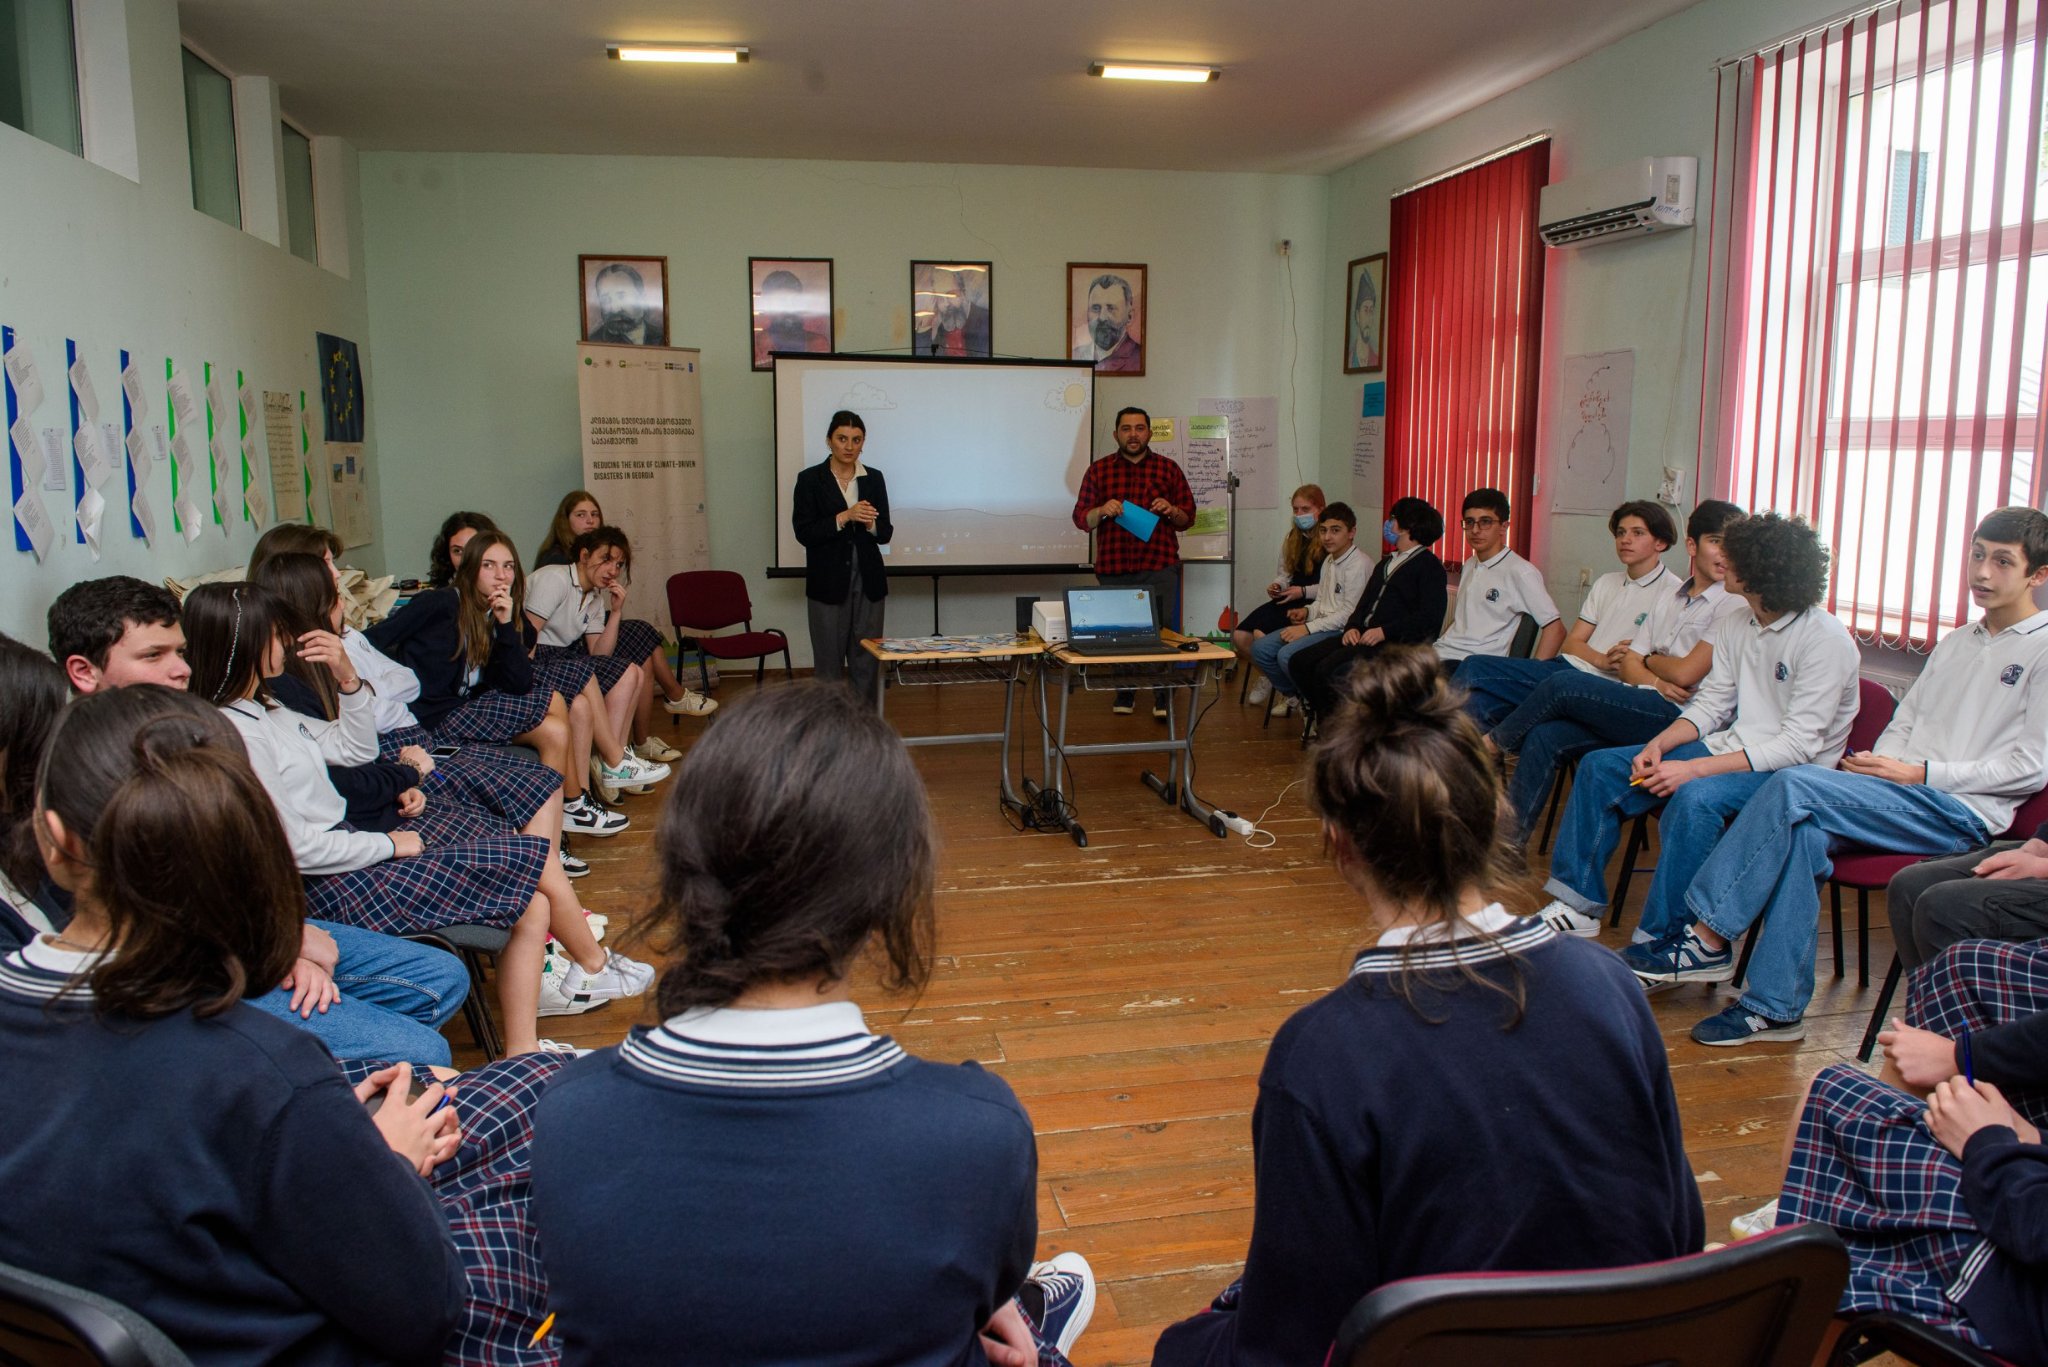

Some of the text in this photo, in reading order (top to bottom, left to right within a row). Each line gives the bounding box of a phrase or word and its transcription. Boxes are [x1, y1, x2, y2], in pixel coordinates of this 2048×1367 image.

[593, 461, 620, 469] REDUCING
[654, 460, 696, 468] CLIMATE-DRIVEN
[593, 471, 654, 480] DISASTERS IN GEORGIA
[1745, 1015, 1769, 1032] N
